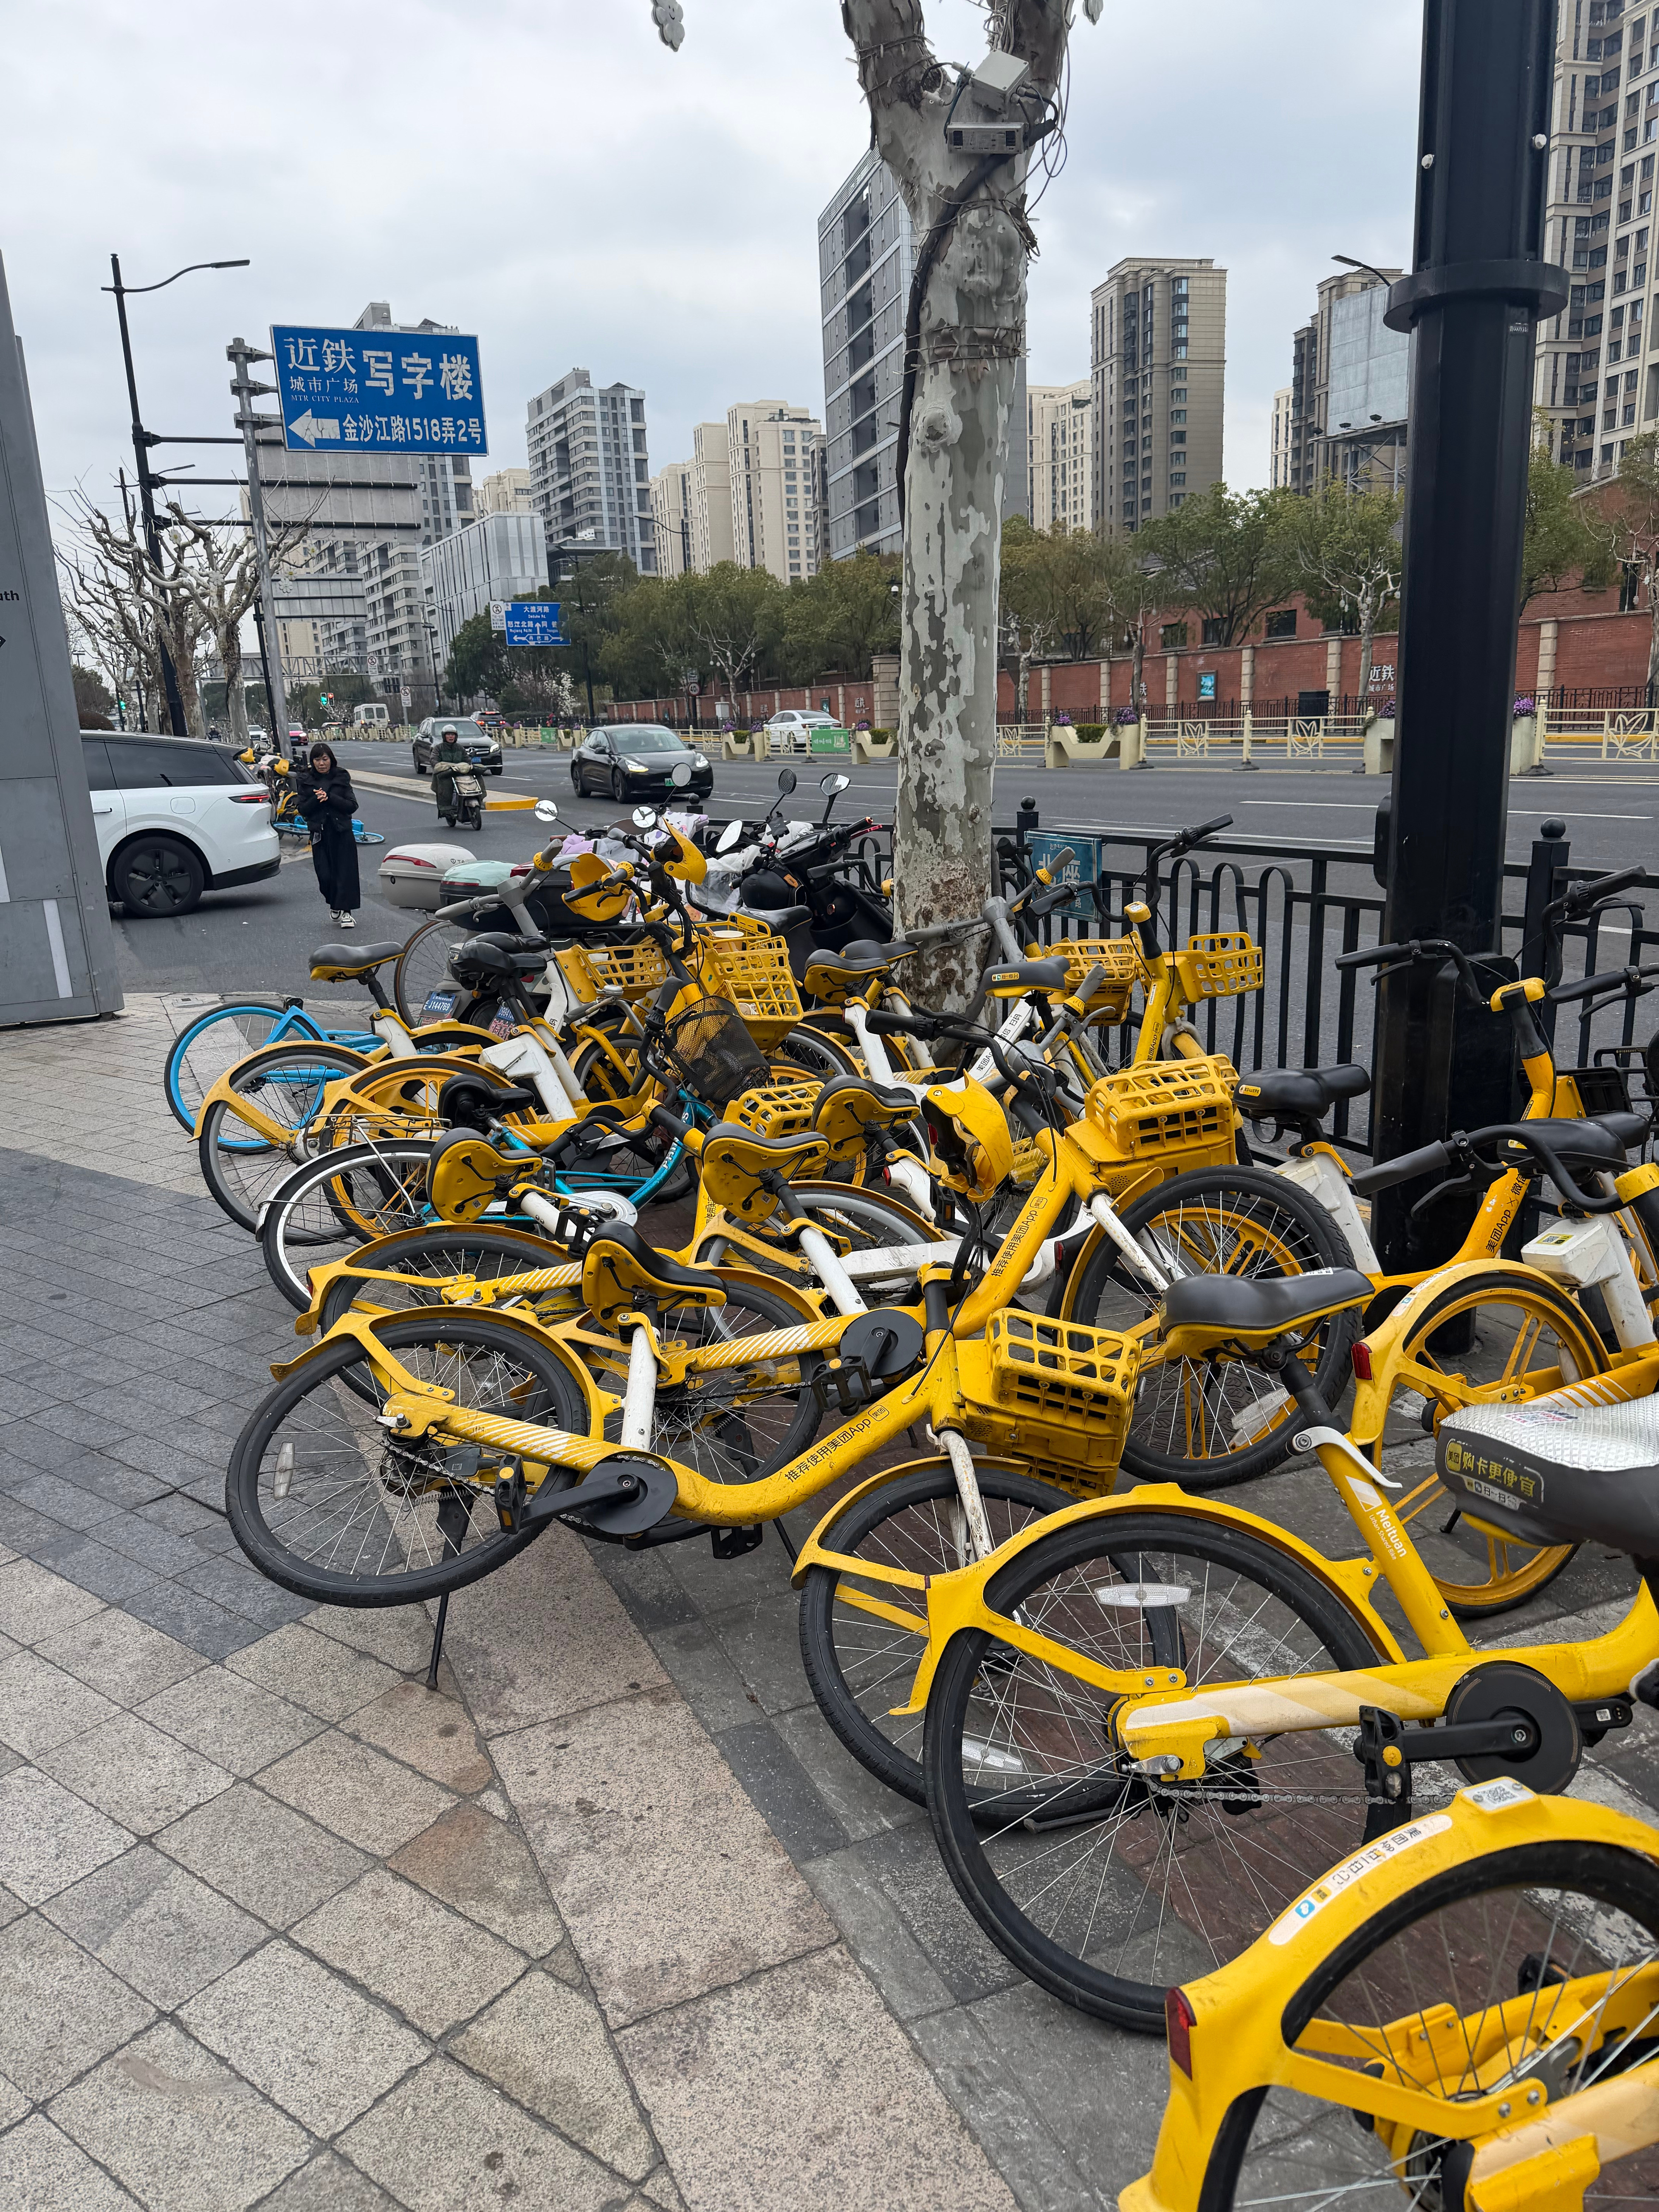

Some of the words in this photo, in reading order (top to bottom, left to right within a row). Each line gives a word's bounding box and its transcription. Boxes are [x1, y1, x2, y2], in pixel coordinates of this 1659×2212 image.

[290, 376, 358, 394] 城市广场
[362, 350, 473, 401] 写字楼
[342, 414, 482, 445] 金沙江路1518弄2号
[428, 1001, 450, 1011] J144769
[991, 1210, 1038, 1277] 推荐使用美团App
[785, 1419, 871, 1482] 推荐使用美团App
[1369, 1514, 1380, 1530] Urban
[1376, 1509, 1407, 1557] Meituan
